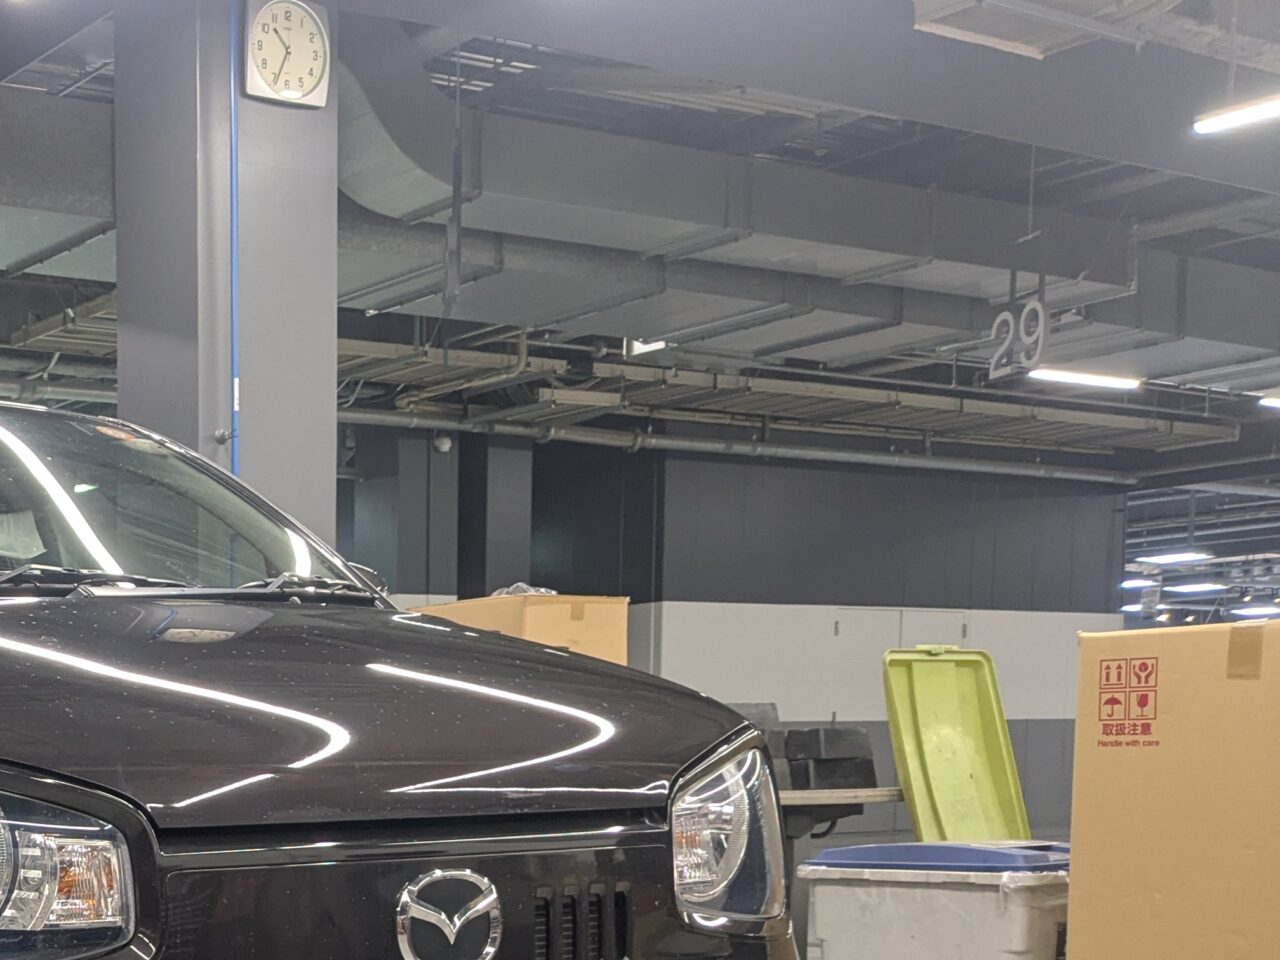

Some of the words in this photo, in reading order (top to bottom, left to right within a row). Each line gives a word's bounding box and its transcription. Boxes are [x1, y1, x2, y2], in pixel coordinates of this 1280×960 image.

[271, 12, 278, 24] 11
[284, 10, 292, 21] 12
[261, 23, 269, 34] 10
[308, 32, 314, 43] 2
[257, 39, 263, 51] 9
[312, 50, 319, 61] 3
[261, 58, 267, 70] 8
[307, 67, 314, 77] 4
[284, 79, 290, 90] 6
[297, 77, 304, 88] 5
[988, 300, 1044, 380] 29
[1098, 739, 1123, 748] Handle
[1125, 739, 1140, 748] with
[1142, 740, 1160, 748] care
